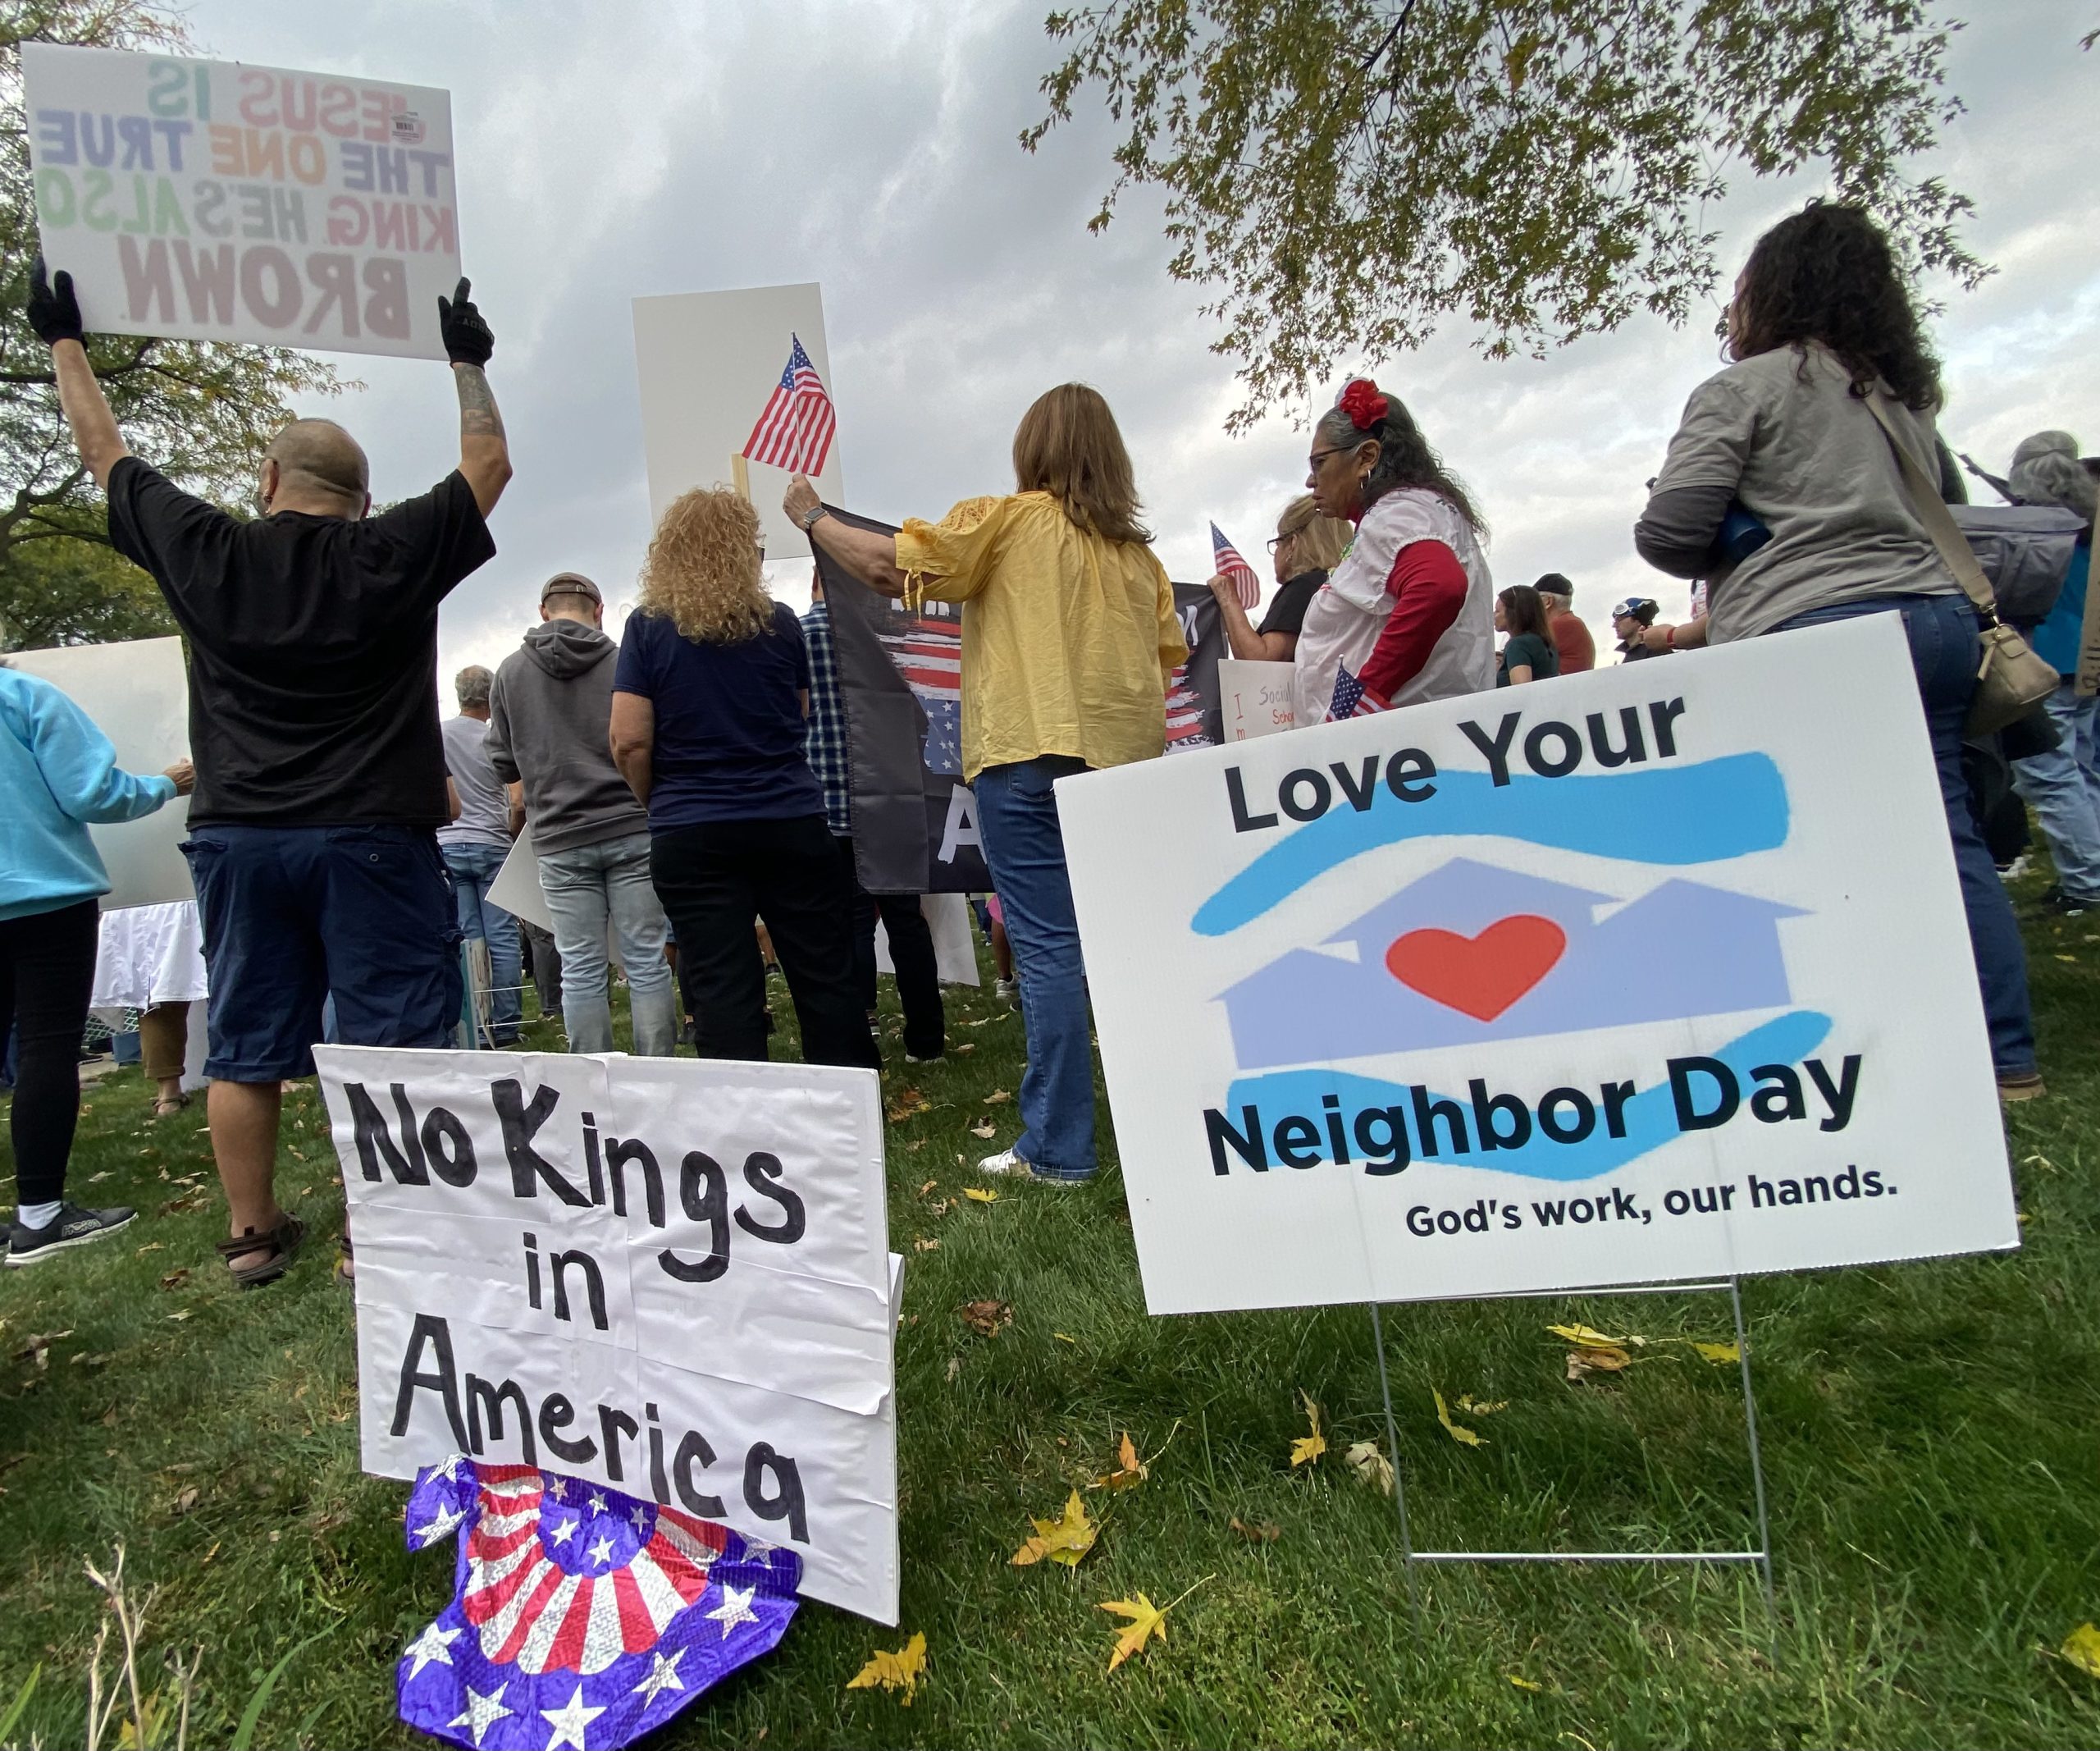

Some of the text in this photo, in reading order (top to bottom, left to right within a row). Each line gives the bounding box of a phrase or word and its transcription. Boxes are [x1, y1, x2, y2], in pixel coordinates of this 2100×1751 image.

[1259, 682, 1292, 706] Social
[1224, 696, 1687, 834] Love Your
[1202, 1054, 1863, 1177] Neighbor Day
[343, 1077, 806, 1283] No Kings
[1406, 1164, 1901, 1237] God's work, our hands.
[522, 1231, 610, 1333] in
[389, 1312, 811, 1546] America
